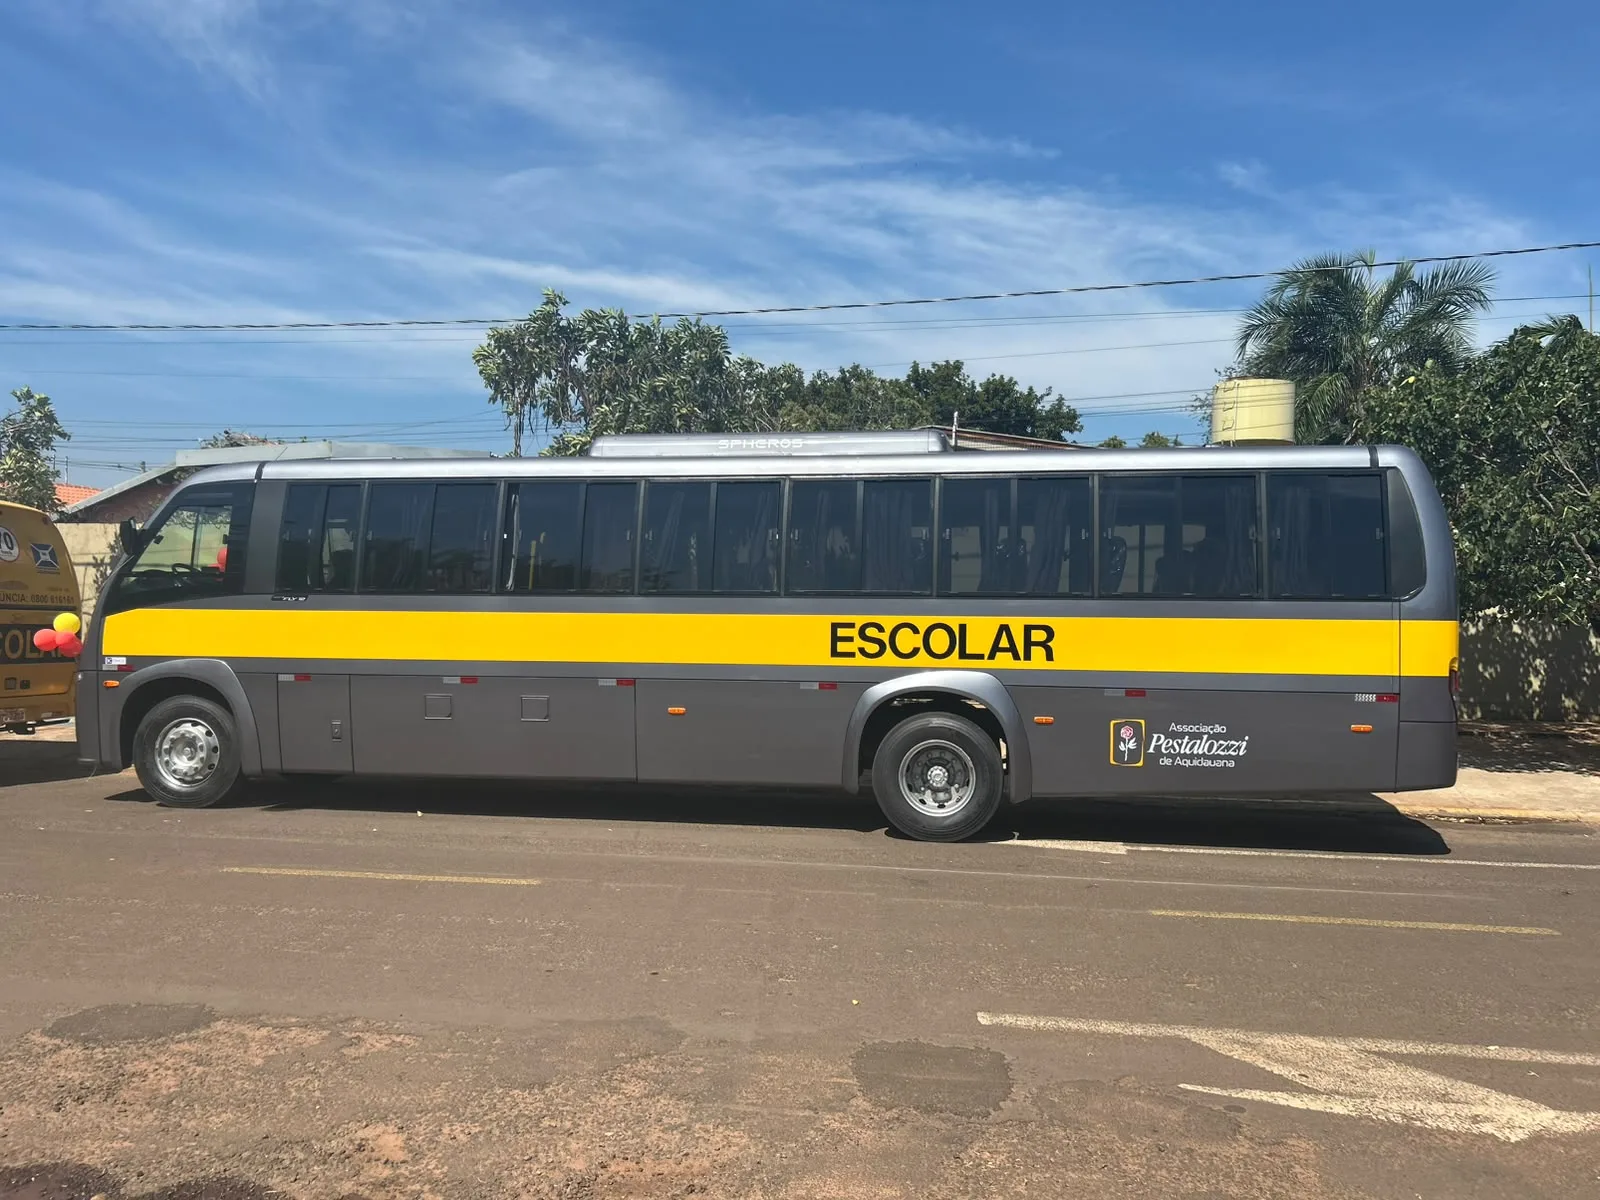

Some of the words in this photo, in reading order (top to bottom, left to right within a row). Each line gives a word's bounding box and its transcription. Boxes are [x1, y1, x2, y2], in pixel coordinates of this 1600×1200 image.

[718, 438, 803, 449] SPHEROS
[830, 621, 1056, 662] ESCOLAR
[1168, 722, 1227, 735] Associação
[1147, 733, 1249, 756] Pestalozzi
[1159, 756, 1172, 766] de
[1174, 756, 1235, 768] Aquidauana
